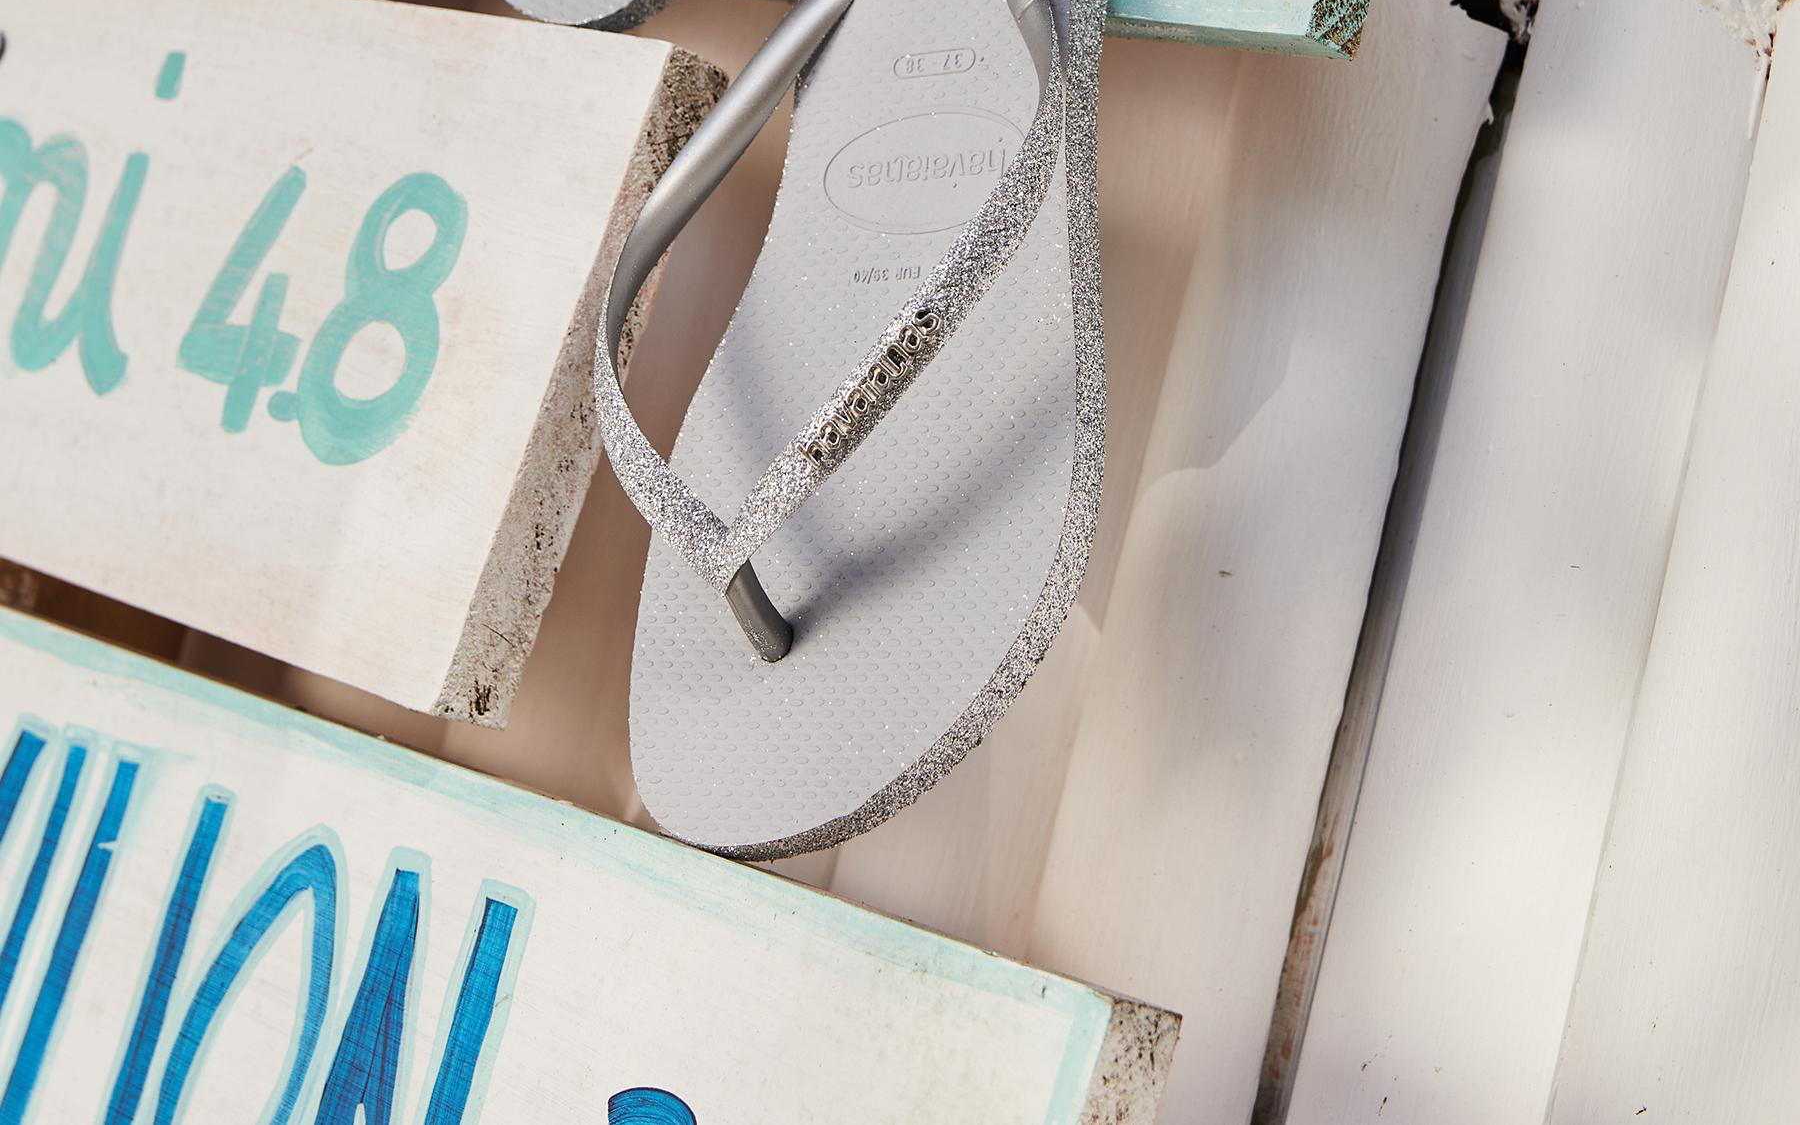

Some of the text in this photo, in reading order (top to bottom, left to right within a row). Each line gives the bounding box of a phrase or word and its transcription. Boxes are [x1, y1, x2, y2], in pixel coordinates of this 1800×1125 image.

[847, 138, 1007, 190] havaianas
[176, 165, 469, 466] 4.8
[795, 307, 943, 470] havaianas
